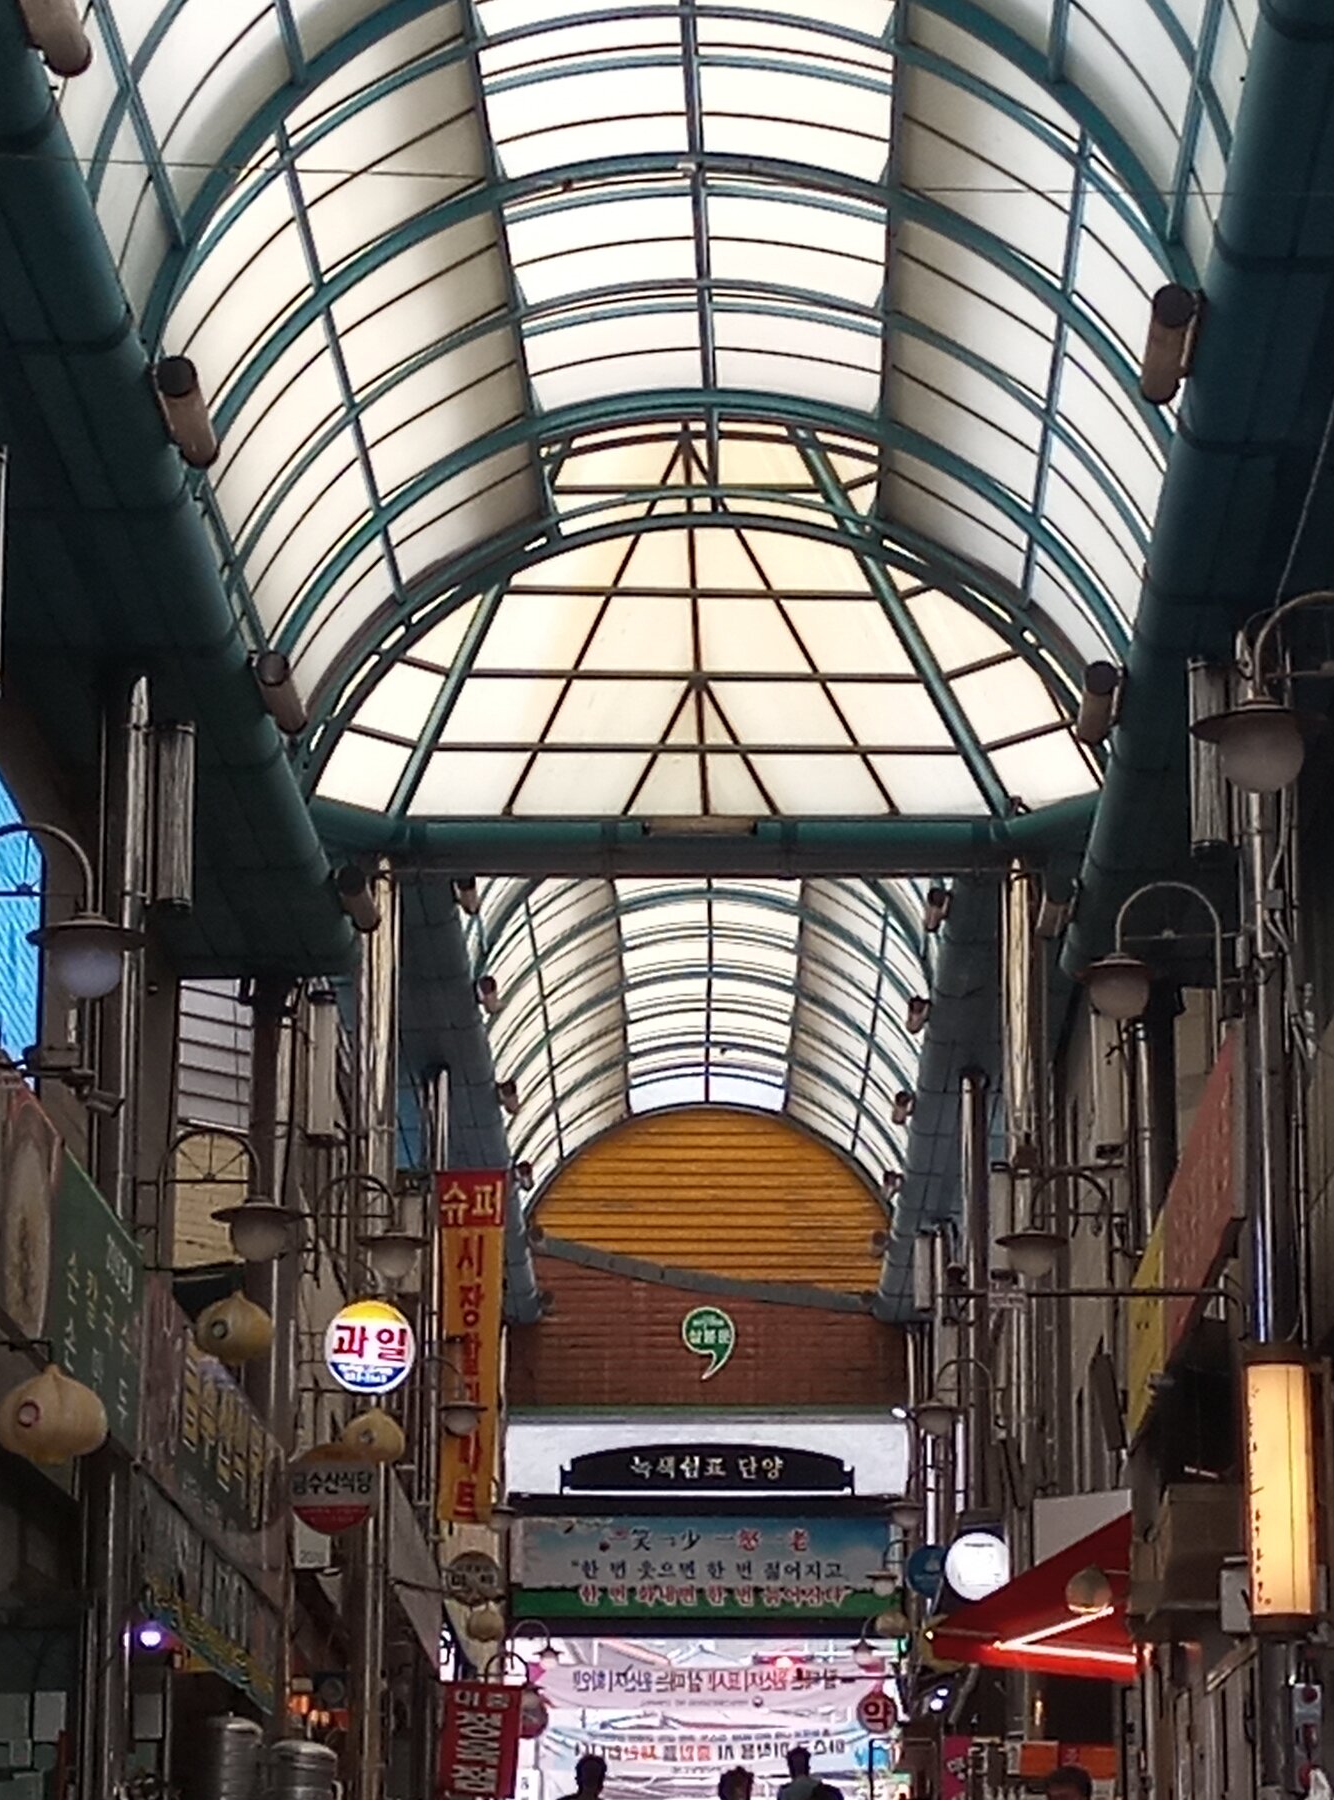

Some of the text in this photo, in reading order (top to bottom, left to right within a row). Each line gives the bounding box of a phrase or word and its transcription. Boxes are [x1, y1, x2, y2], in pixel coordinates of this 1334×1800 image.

[441, 1179, 504, 1226] 슈퍼
[333, 1322, 410, 1362] 과일
[737, 1455, 784, 1481] 단양
[291, 1471, 373, 1497] 금수산식당
[864, 1701, 891, 1728] 약
